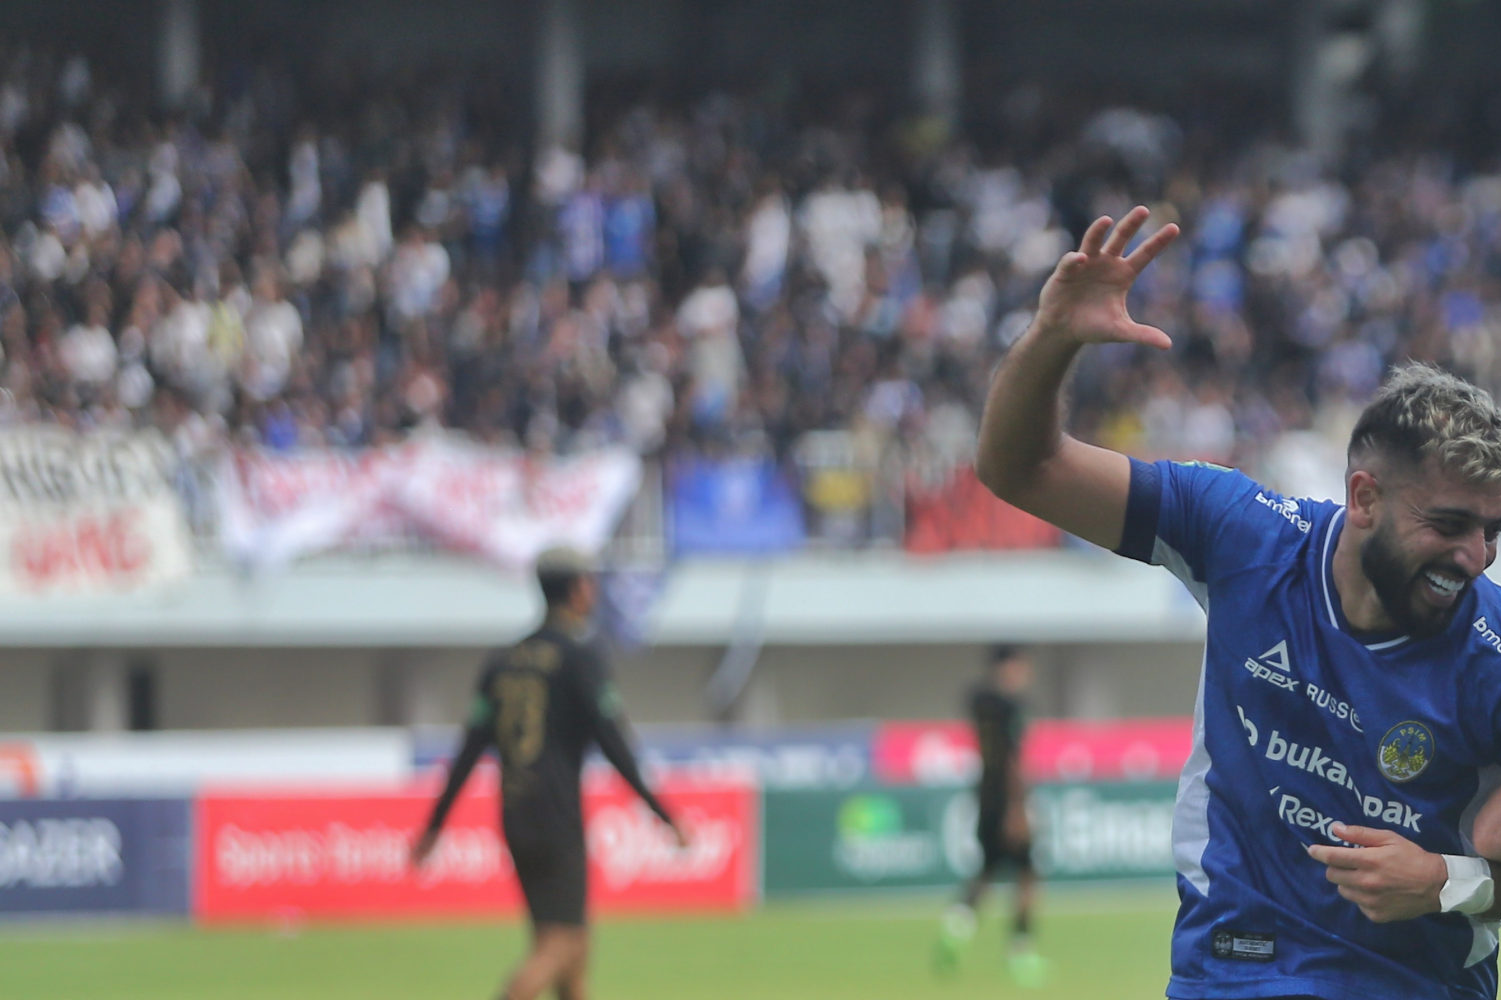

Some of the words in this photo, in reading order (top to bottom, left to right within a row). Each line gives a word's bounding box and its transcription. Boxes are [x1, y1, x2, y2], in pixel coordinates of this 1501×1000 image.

[1244, 657, 1300, 692] apex
[1399, 726, 1427, 742] PSIM
[1265, 730, 1423, 833] bukapak
[1278, 794, 1366, 849] Rexo
